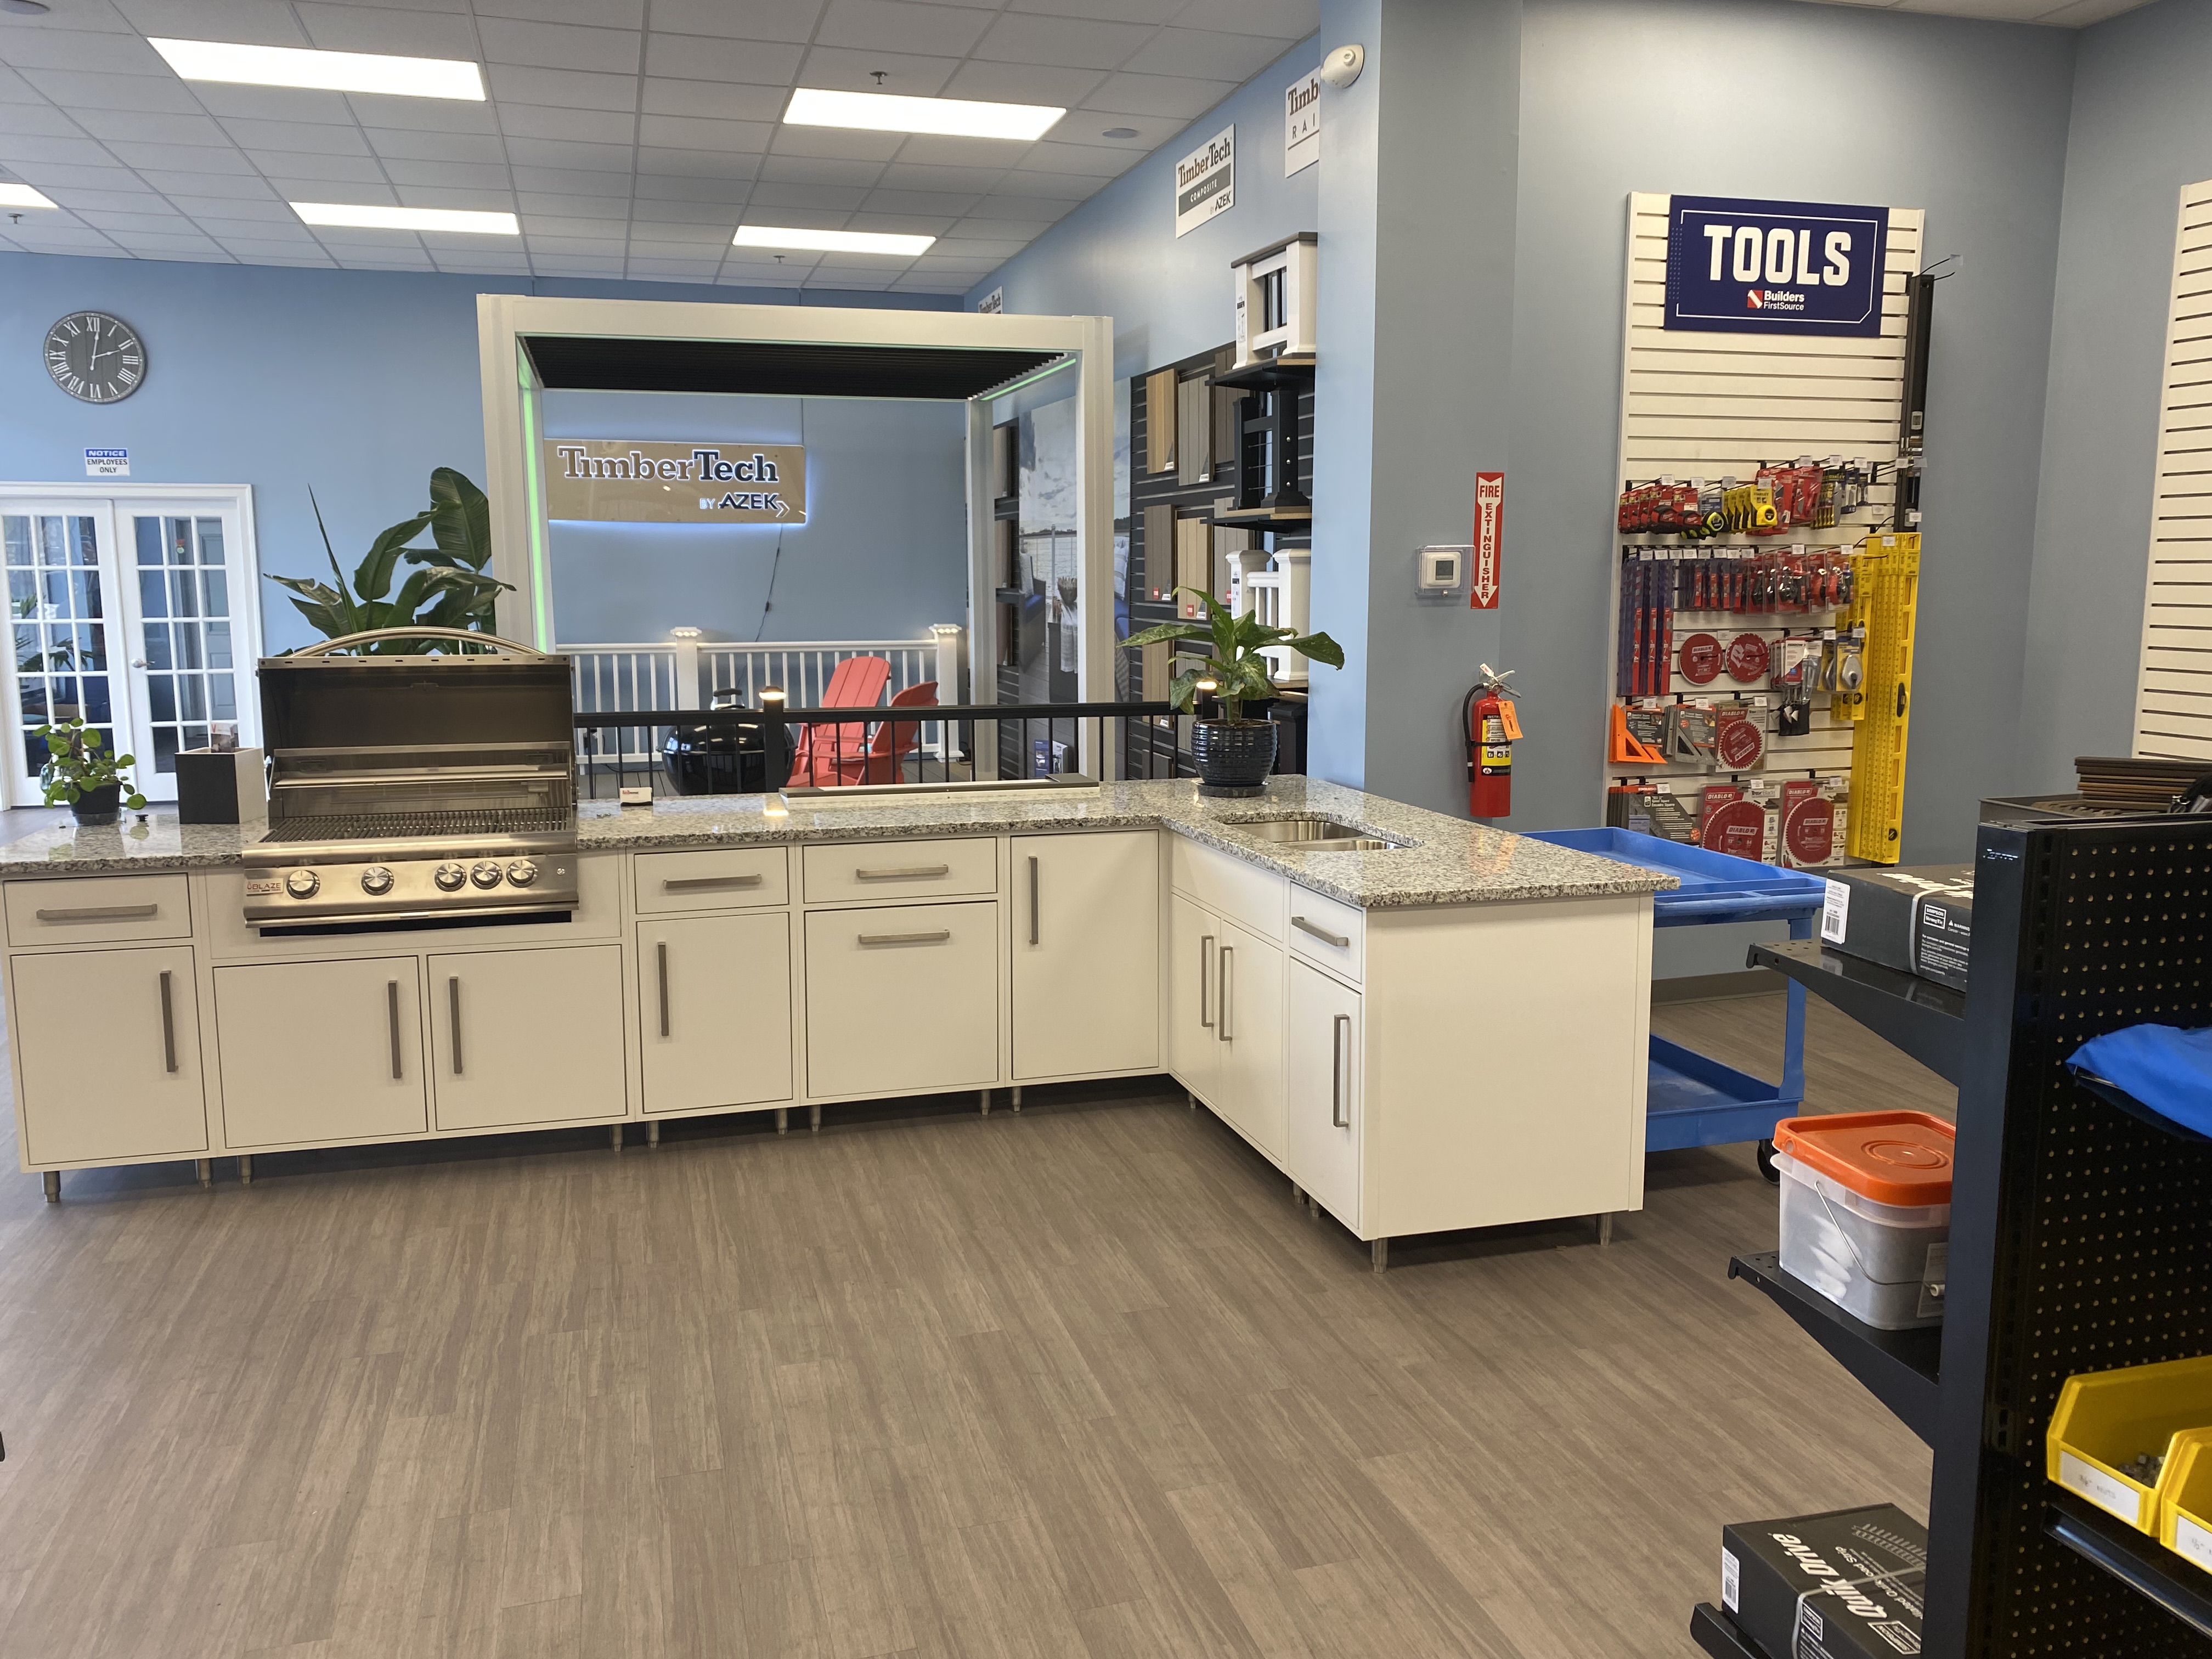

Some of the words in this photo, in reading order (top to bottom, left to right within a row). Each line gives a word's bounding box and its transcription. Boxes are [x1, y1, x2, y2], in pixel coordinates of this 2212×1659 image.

[1288, 77, 1321, 116] Timb
[1178, 137, 1231, 188] TimberTech
[1190, 178, 1217, 203] COMPOSITE
[1215, 190, 1231, 212] AZEK
[1703, 224, 1852, 286] TOOLS
[1763, 302, 1804, 311] FirstSource
[1764, 290, 1805, 302] Builders
[557, 445, 780, 483] TimberTech
[699, 498, 716, 510] BY
[718, 492, 780, 510] AZEK
[1479, 485, 1500, 498] FIRE
[1481, 503, 1493, 599] EXTINGUISHER
[1926, 907, 1944, 917] SIMPSON
[1772, 1533, 1840, 1577] Drive
[1819, 1577, 1888, 1619] Quik
